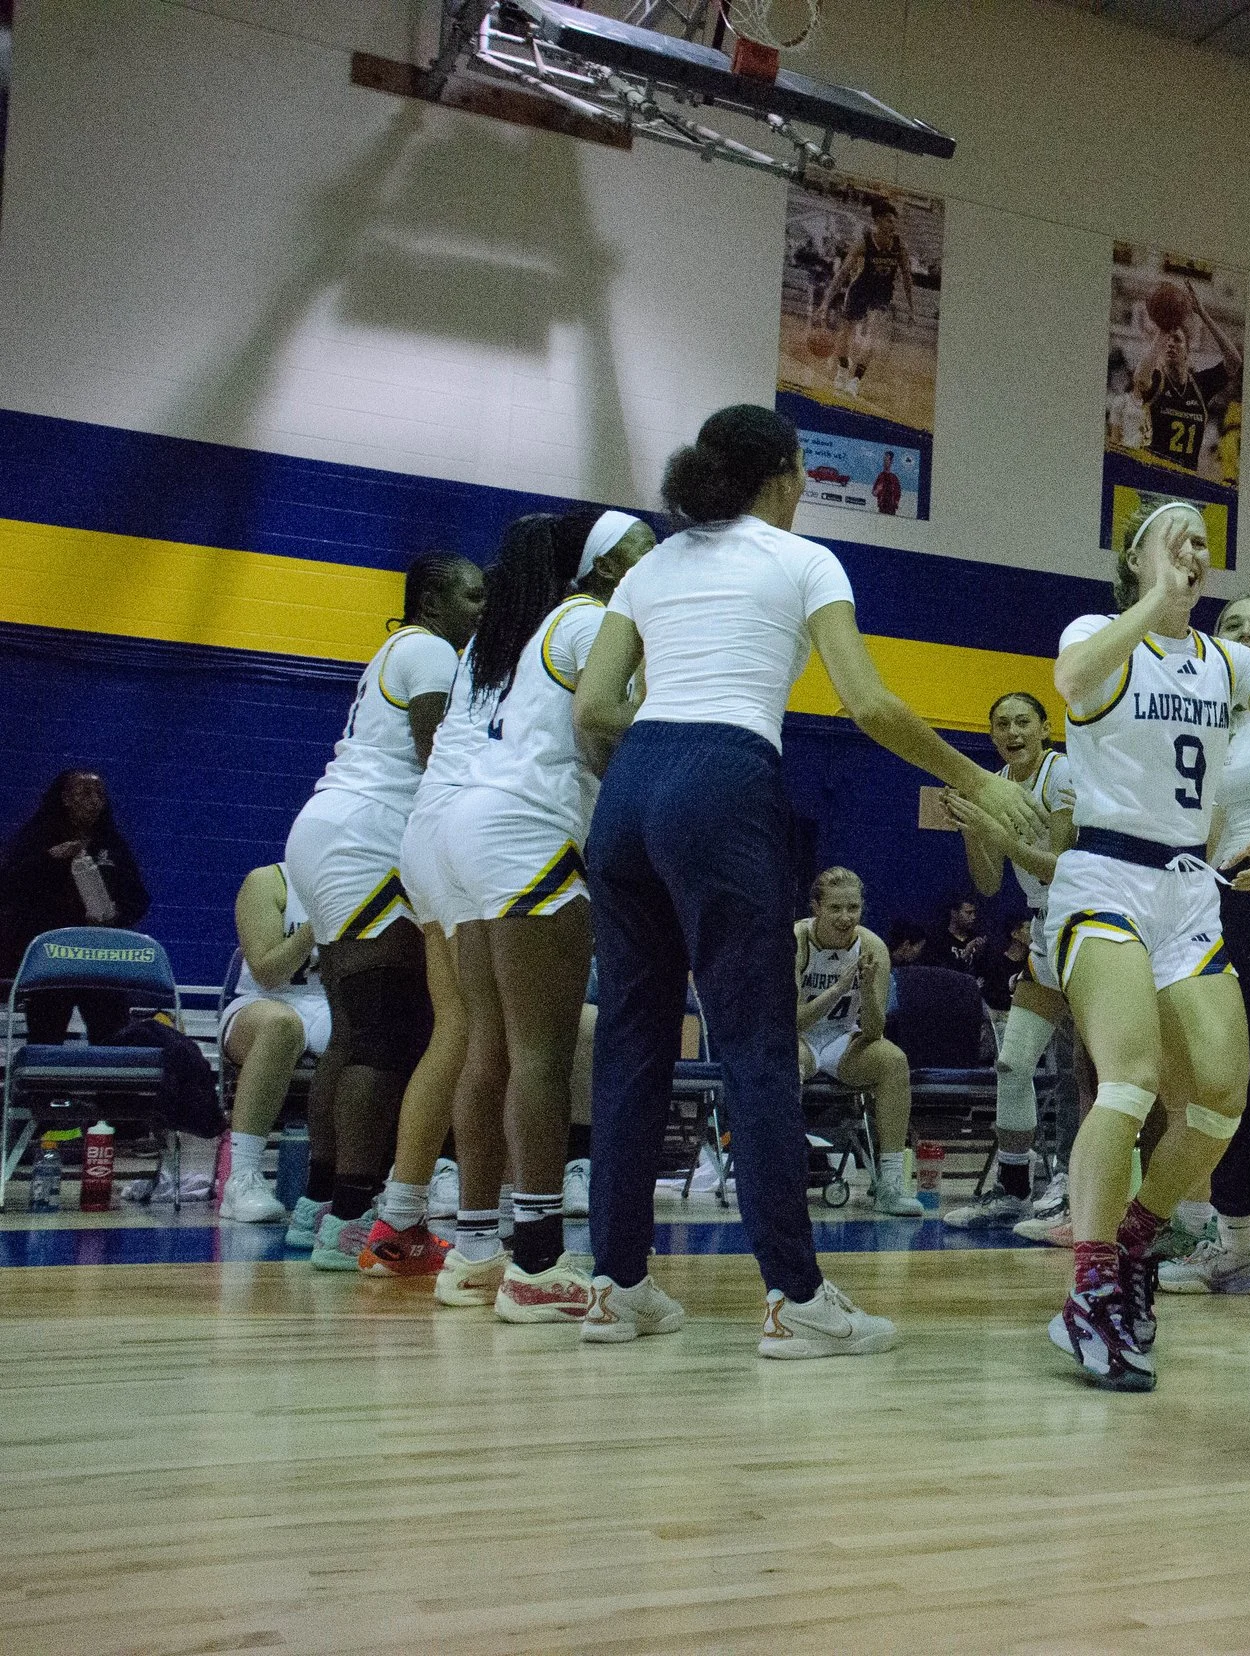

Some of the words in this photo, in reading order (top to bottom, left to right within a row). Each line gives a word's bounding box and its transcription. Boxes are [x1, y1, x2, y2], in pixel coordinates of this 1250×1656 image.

[1168, 420, 1197, 455] 21
[1174, 734, 1206, 810] 9
[44, 943, 155, 963] VOYAGEURS
